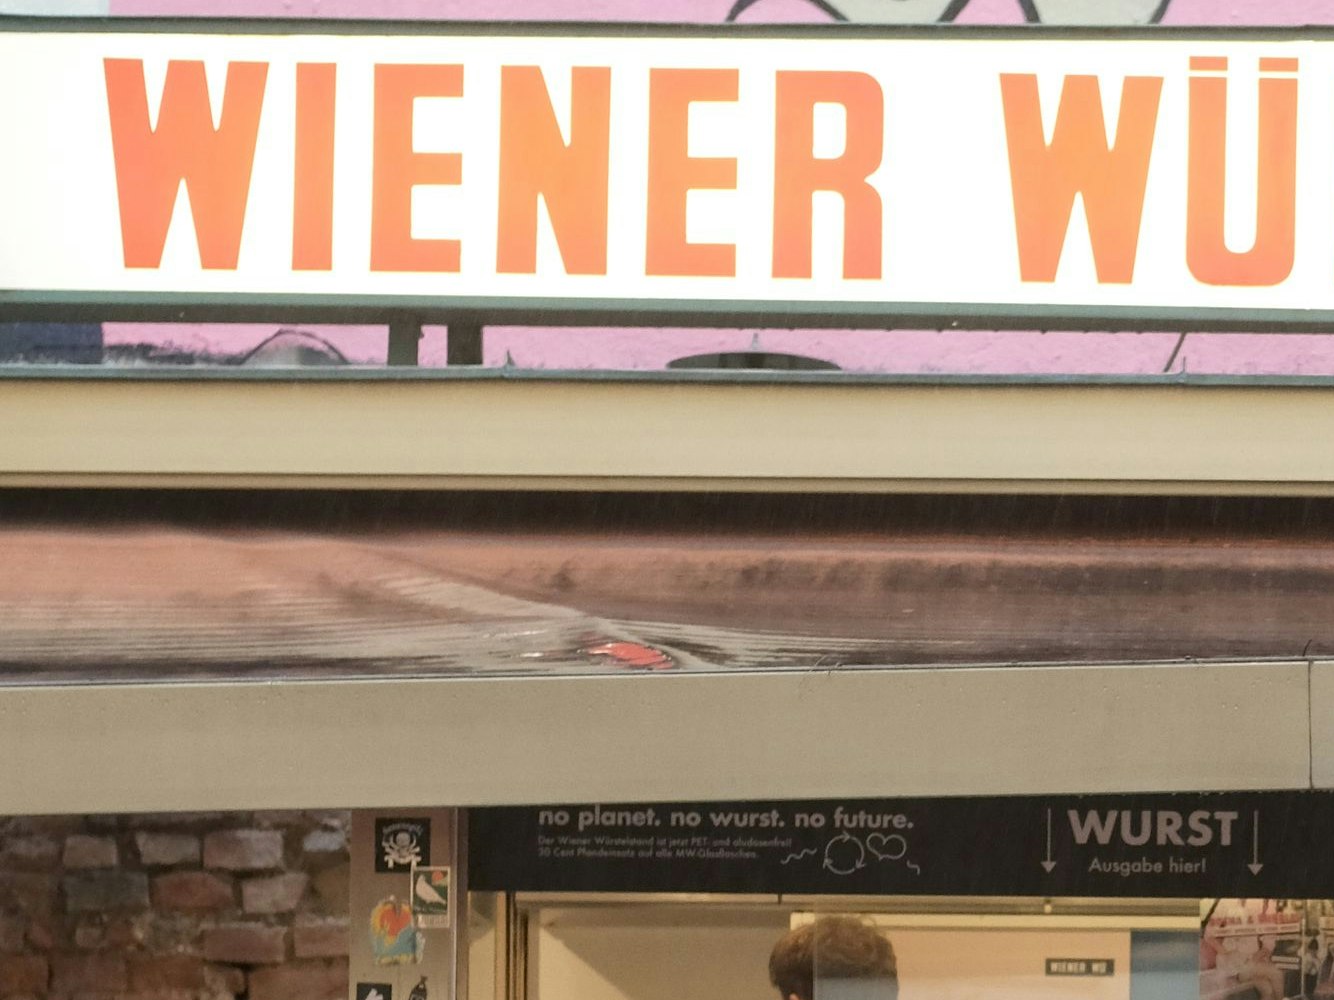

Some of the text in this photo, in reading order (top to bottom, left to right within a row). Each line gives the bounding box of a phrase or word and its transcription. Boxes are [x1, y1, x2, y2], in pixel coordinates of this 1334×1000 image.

[103, 57, 885, 281] WIENER
[538, 804, 914, 832] no planet. no wurst. no future.
[1067, 809, 1239, 846] WURST
[1088, 857, 1207, 877] Ausgabe hier!
